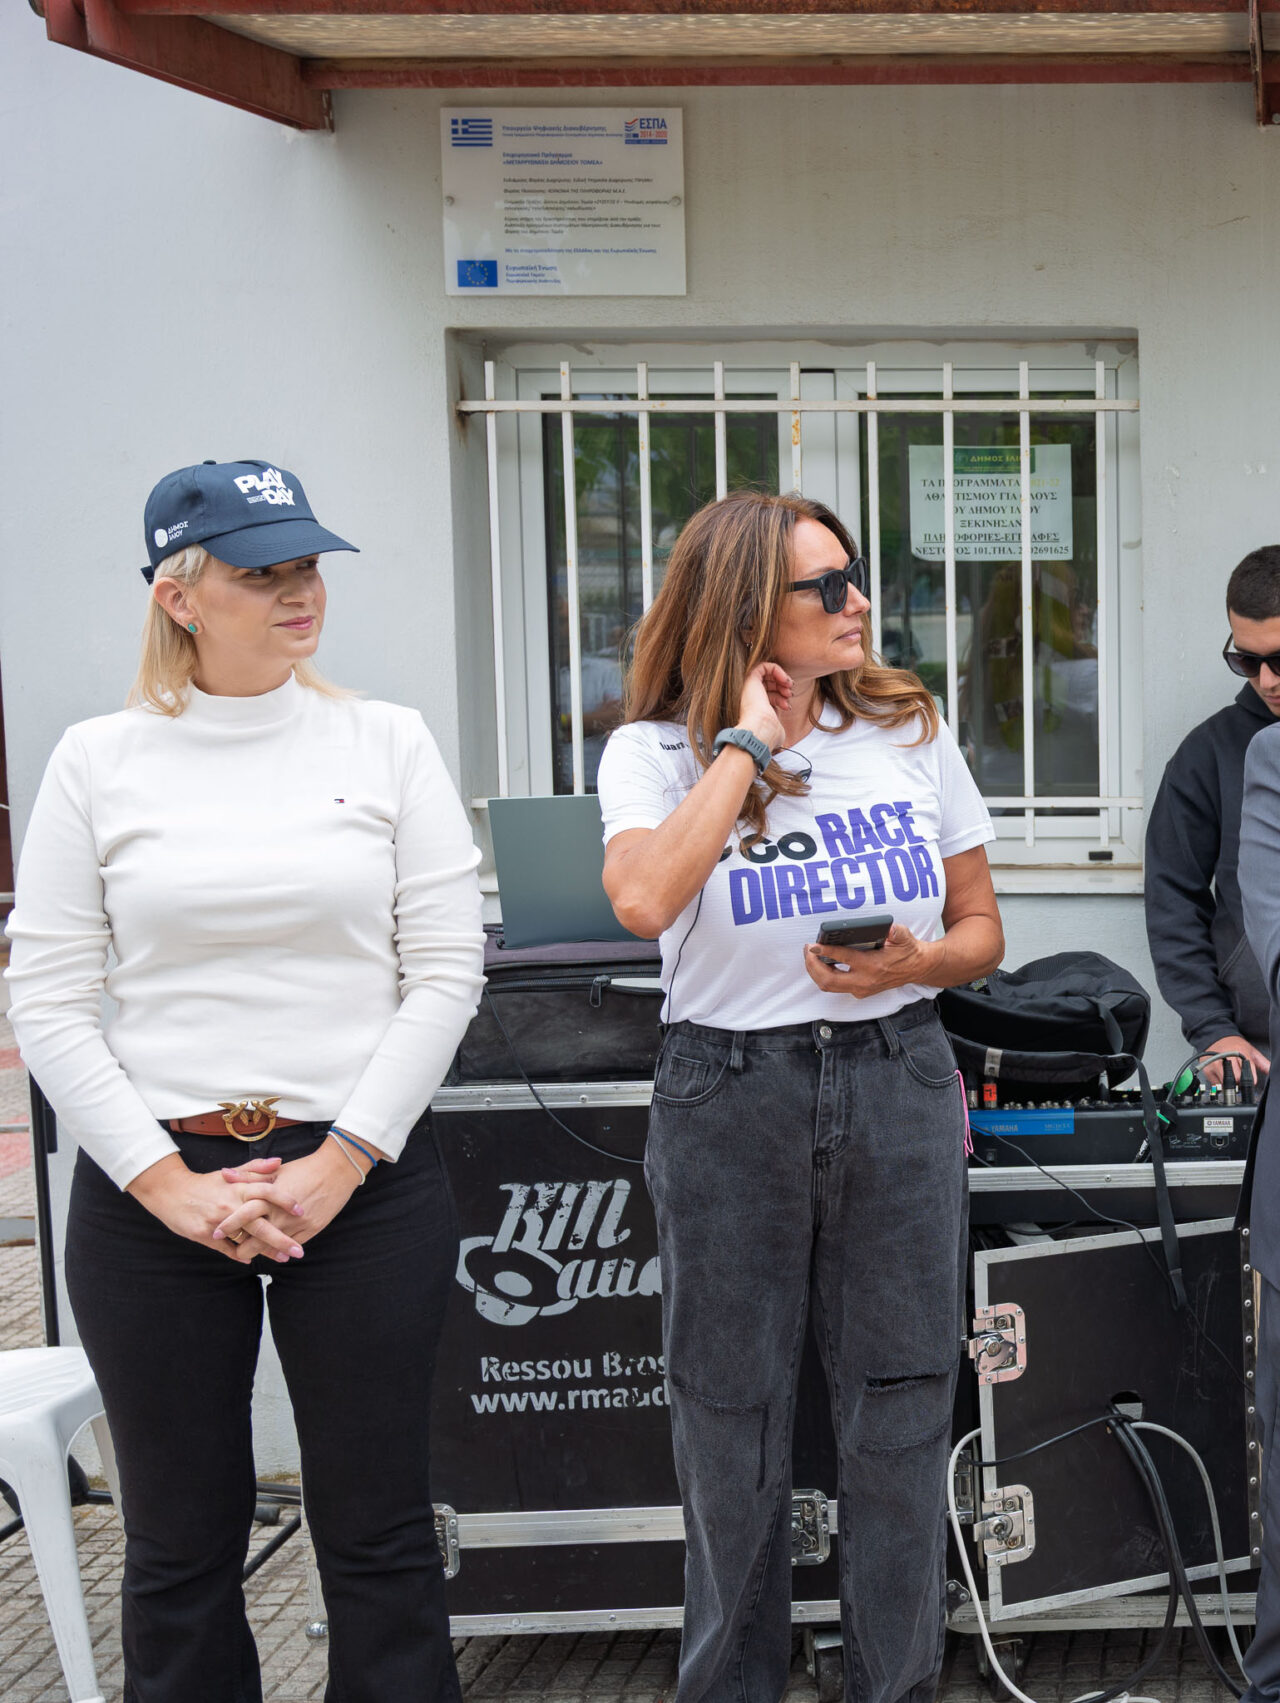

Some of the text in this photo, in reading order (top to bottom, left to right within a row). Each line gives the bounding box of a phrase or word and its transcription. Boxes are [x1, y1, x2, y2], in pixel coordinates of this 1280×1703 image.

[639, 117, 668, 129] ΕΣΠΑ
[969, 455, 1003, 463] ΔΗΜΟΣ
[233, 467, 287, 493] PLAY
[921, 479, 935, 488] ΤΑ
[938, 479, 1021, 488] ΠΟΓΡΑΜΜΑΤΑ
[263, 488, 295, 506] DAY
[924, 492, 1058, 501] ΑΘΛΤΙΣΜΟΥ ΓΙΑ ΛΟΥΣ
[969, 506, 1008, 515] ΔΗΜΟΥ
[169, 521, 188, 534] ΔΗΜΟΣ
[960, 519, 1023, 528] ΞΕΚΙΝΗΣΑΝ
[923, 532, 1060, 543] ΠΛΗΟΦΟΡΙΕΣ-ΕΓΓΑΦΕΣ
[814, 801, 927, 858] RACE
[729, 844, 940, 926] DIRECTOR
[480, 1356, 592, 1382] Ressou
